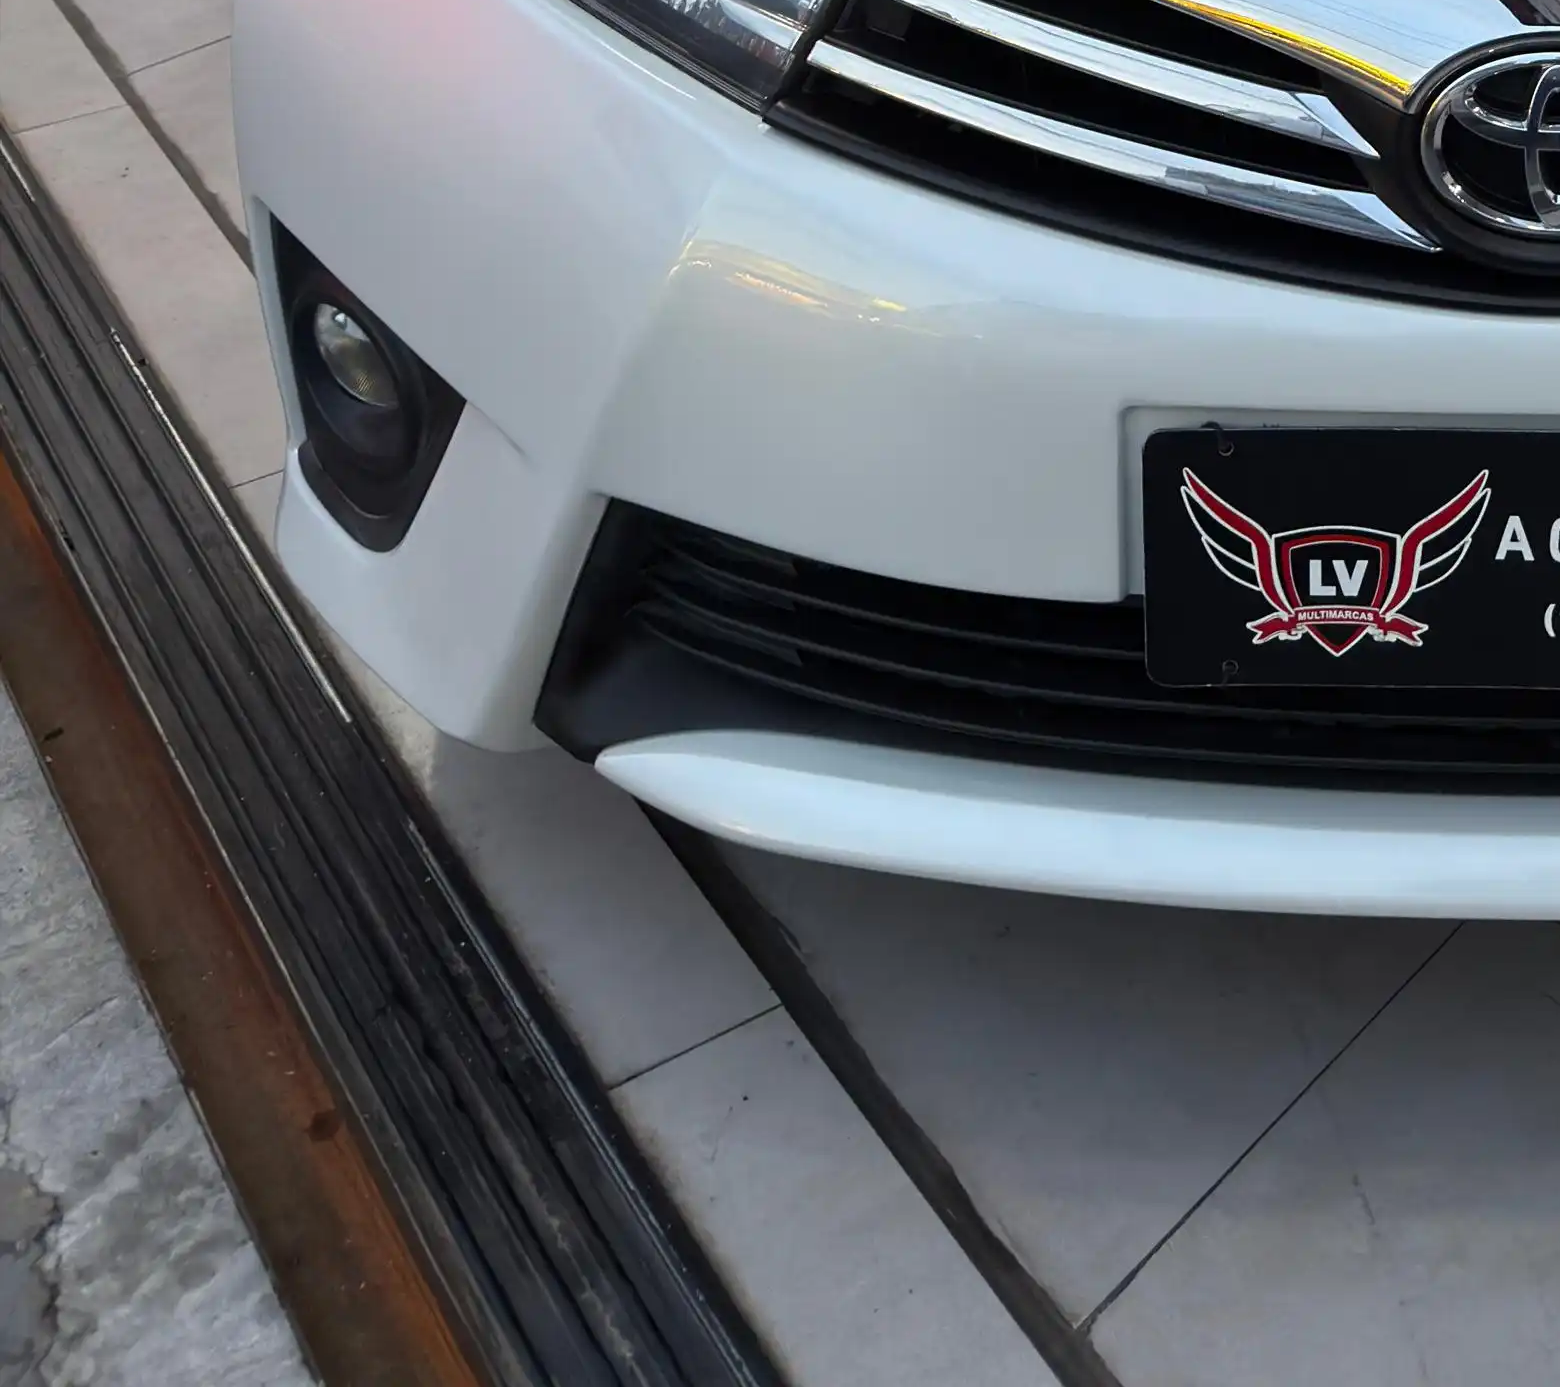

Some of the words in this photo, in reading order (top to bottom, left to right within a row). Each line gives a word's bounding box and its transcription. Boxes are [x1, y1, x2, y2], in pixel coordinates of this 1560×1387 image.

[1495, 515, 1535, 562] A
[1309, 559, 1369, 597] LV
[1298, 609, 1375, 622] MULTIMARCAS
